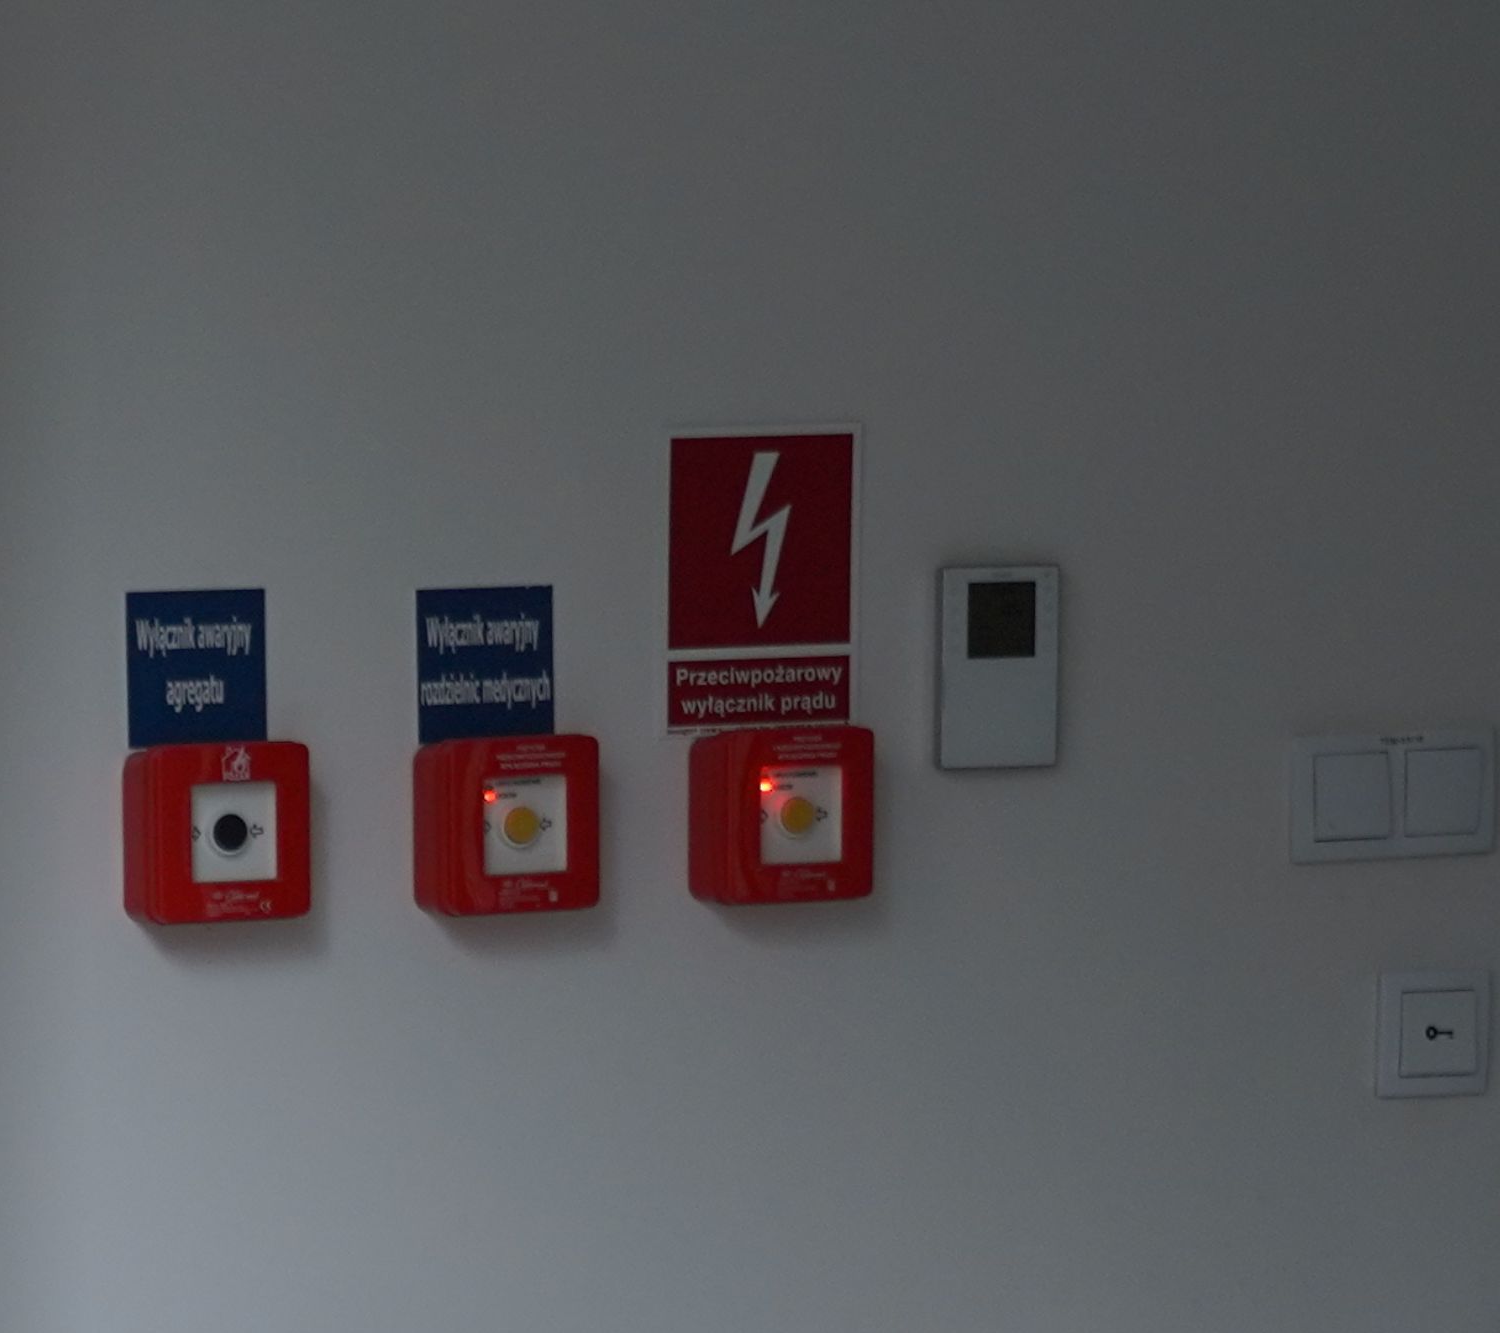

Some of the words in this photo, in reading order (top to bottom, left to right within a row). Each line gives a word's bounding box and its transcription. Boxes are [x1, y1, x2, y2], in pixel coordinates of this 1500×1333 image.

[135, 616, 196, 658] Wyłącznik
[197, 615, 251, 656] awaryjny
[426, 613, 484, 655] Wyłącznik
[485, 612, 540, 652] awaryjny
[166, 674, 224, 713] agregatu
[421, 672, 481, 706] rozdzielnic
[482, 669, 550, 709] medycznych
[675, 664, 842, 688] Przeciwpożarowy
[681, 694, 774, 719] wyłącznik
[781, 692, 836, 716] prądu
